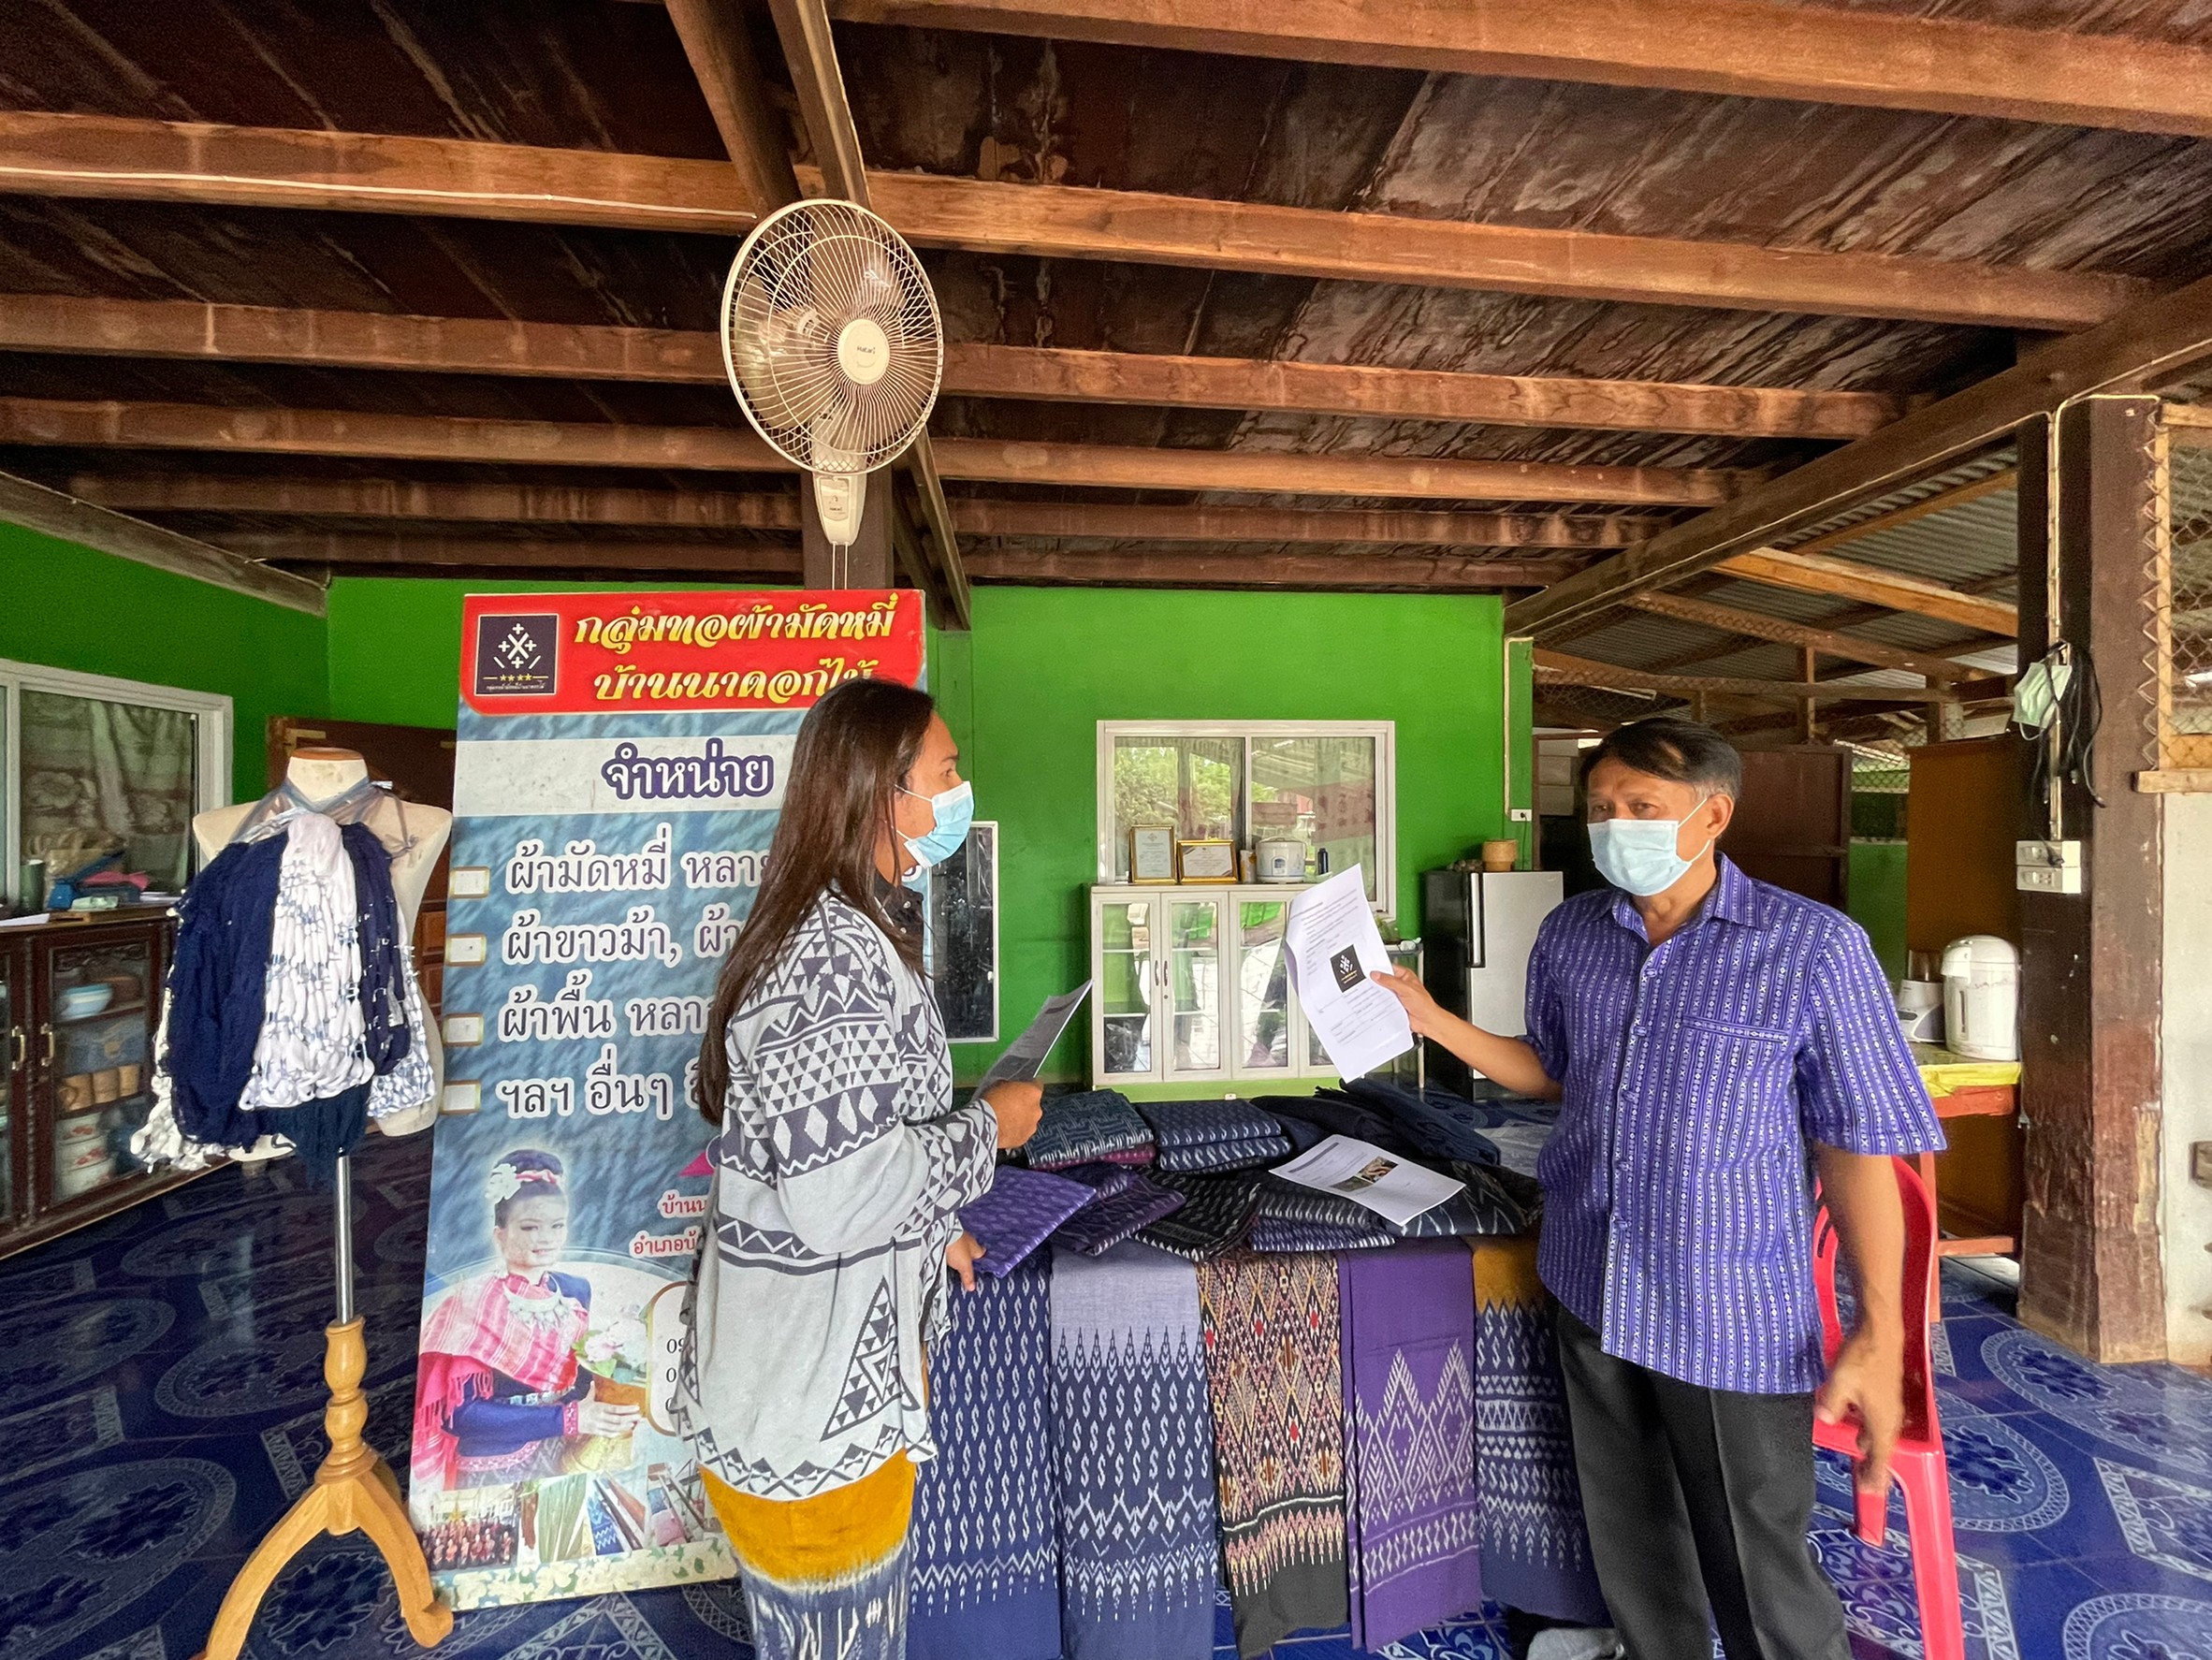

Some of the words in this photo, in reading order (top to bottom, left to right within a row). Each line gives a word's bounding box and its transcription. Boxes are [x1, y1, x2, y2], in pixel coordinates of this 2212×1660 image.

[574, 591, 900, 655] กลุ่มทอผ้ามัดหมี่
[604, 740, 771, 796] จำหน่าย
[510, 826, 667, 890] ผ้ามัดหมี่
[506, 909, 679, 964] ผ้าขาวม้า,
[502, 972, 611, 1037] ผ้าพื้น
[630, 1000, 715, 1031] หลา
[501, 1080, 570, 1114] ฯลฯ
[589, 1047, 668, 1115] อื่นๆ
